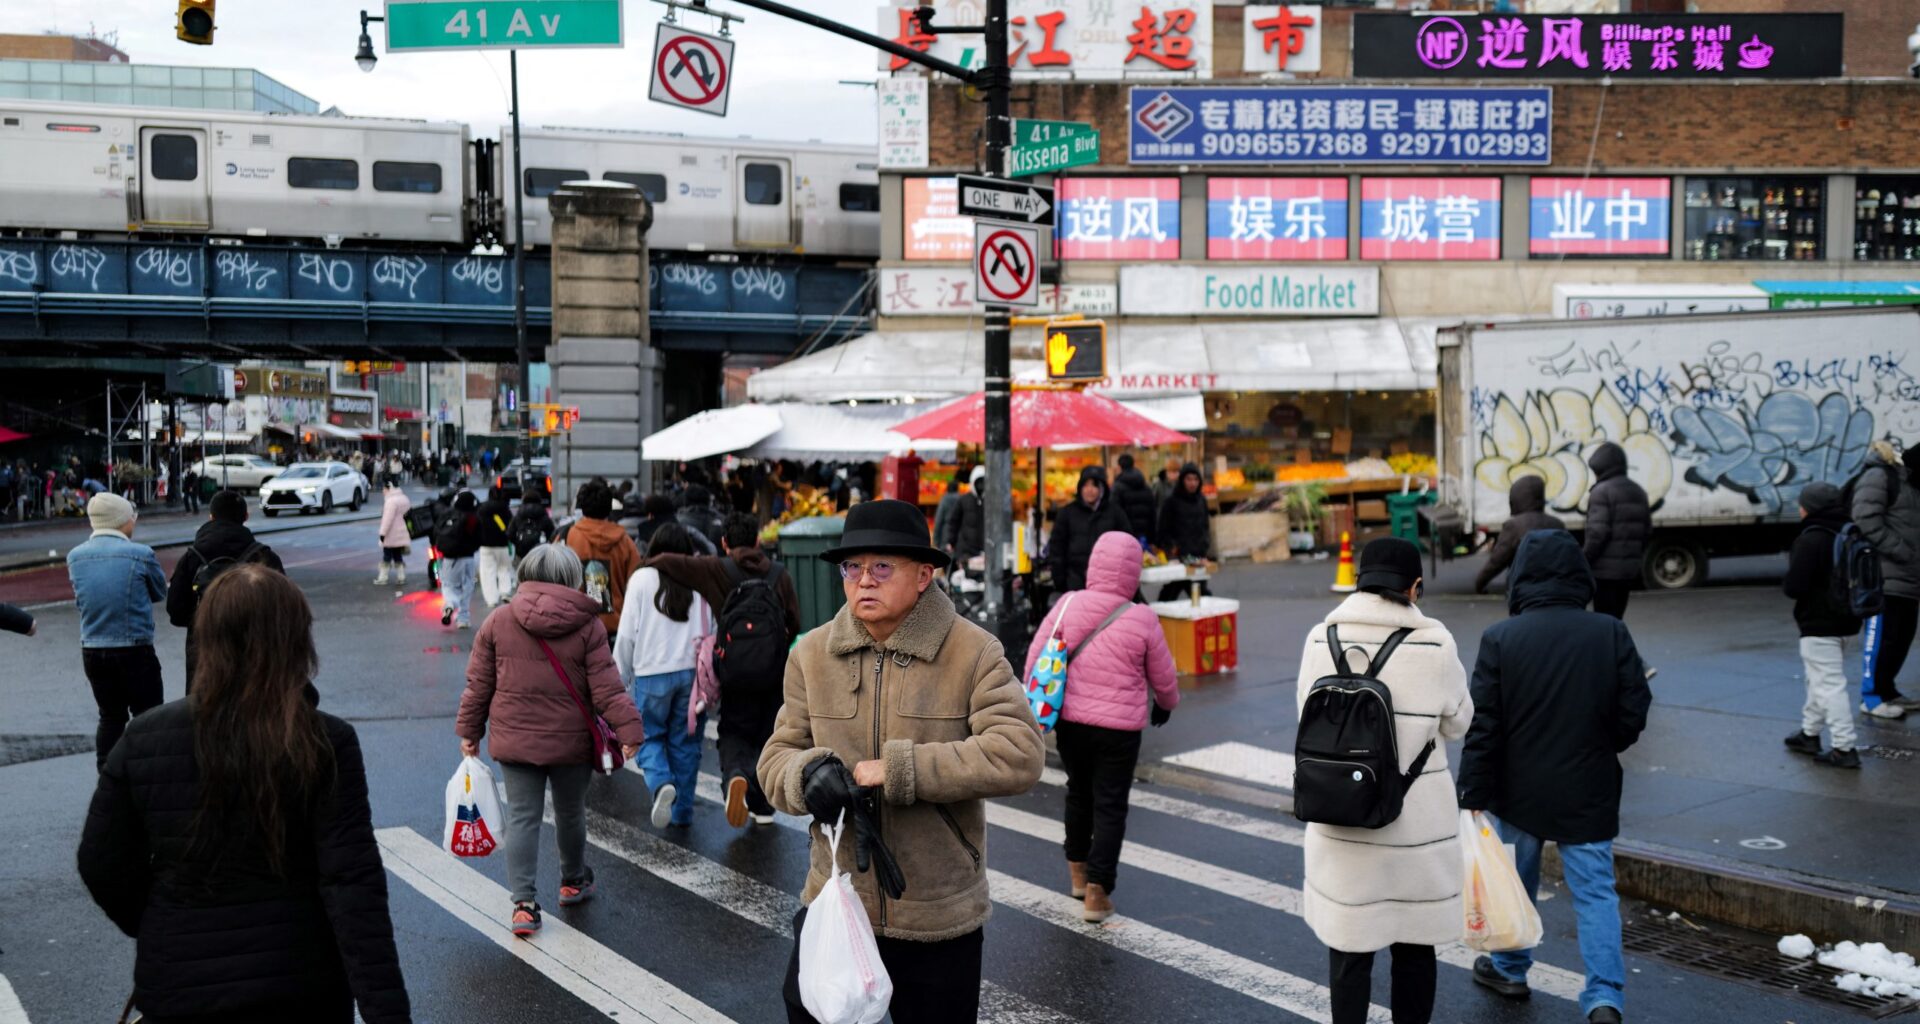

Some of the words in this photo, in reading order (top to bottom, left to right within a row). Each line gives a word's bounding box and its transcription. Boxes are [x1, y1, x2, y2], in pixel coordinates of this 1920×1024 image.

[444, 8, 488, 38] 41
[506, 8, 561, 37] Av
[1691, 24, 1732, 41] Hall
[1425, 31, 1460, 60] NF
[1476, 17, 1590, 69] 逆风
[1602, 41, 1725, 71] 娱乐城
[1030, 124, 1050, 142] 41
[1202, 133, 1368, 155] 9096557368
[1381, 133, 1547, 156] 9297102993
[1011, 143, 1069, 173] Kissena
[1074, 134, 1097, 154] Blvd
[973, 189, 1001, 208] ONE
[1013, 194, 1042, 213] WAY
[1549, 188, 1648, 241] 业中
[1067, 196, 1168, 242] 逆风
[1228, 195, 1327, 243] 娱乐
[1380, 194, 1480, 243] 城营
[1205, 274, 1264, 310] Food
[1271, 273, 1357, 310] Market
[1121, 373, 1220, 388] MARKET
